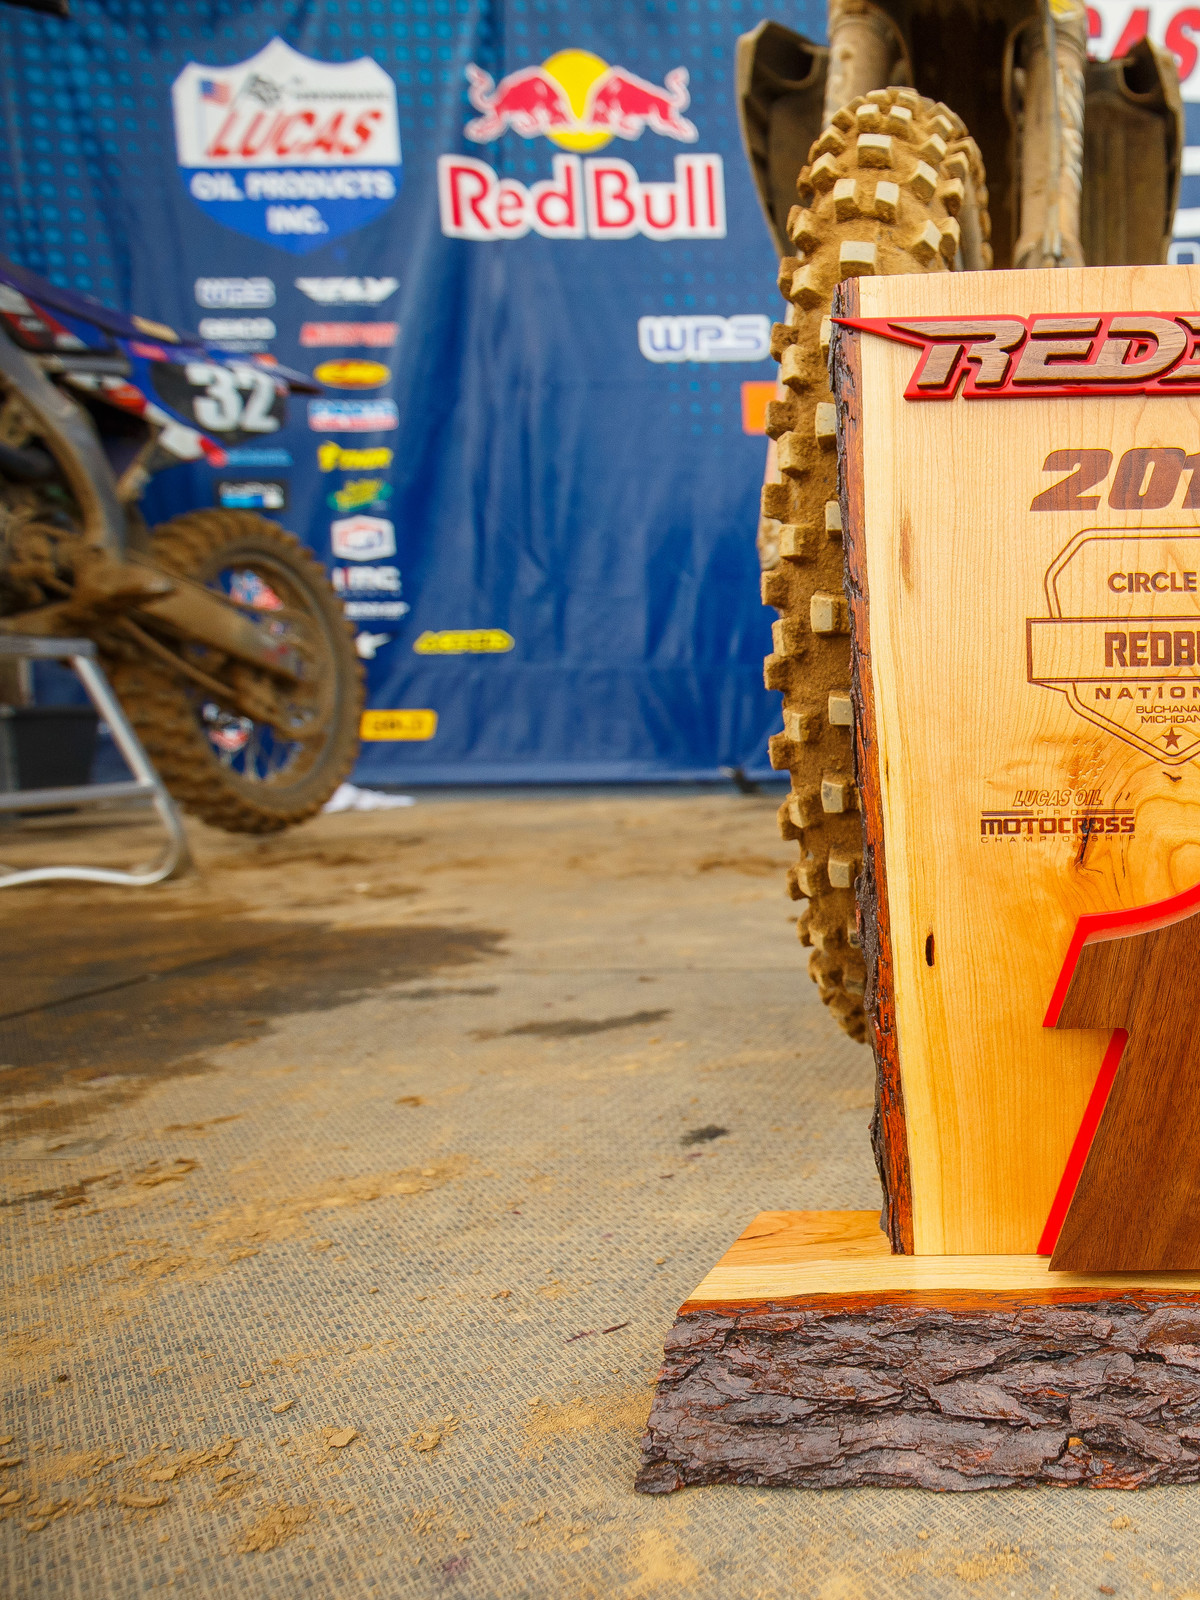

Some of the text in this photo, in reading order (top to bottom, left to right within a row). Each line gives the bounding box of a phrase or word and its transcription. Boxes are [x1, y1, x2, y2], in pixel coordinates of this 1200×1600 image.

[206, 110, 384, 159] LUCAS
[190, 169, 396, 201] OIL PRODUCTS
[442, 158, 722, 236] Red Bull
[641, 320, 767, 357] WPS
[185, 361, 282, 433] 32
[1107, 571, 1198, 594] CIRCLE
[1012, 788, 1103, 807] LUCAS OIL
[980, 816, 1136, 836] MOTOCROSS
[1036, 808, 1080, 817] PRO
[980, 834, 1136, 844] CHAMPIONSHIP
